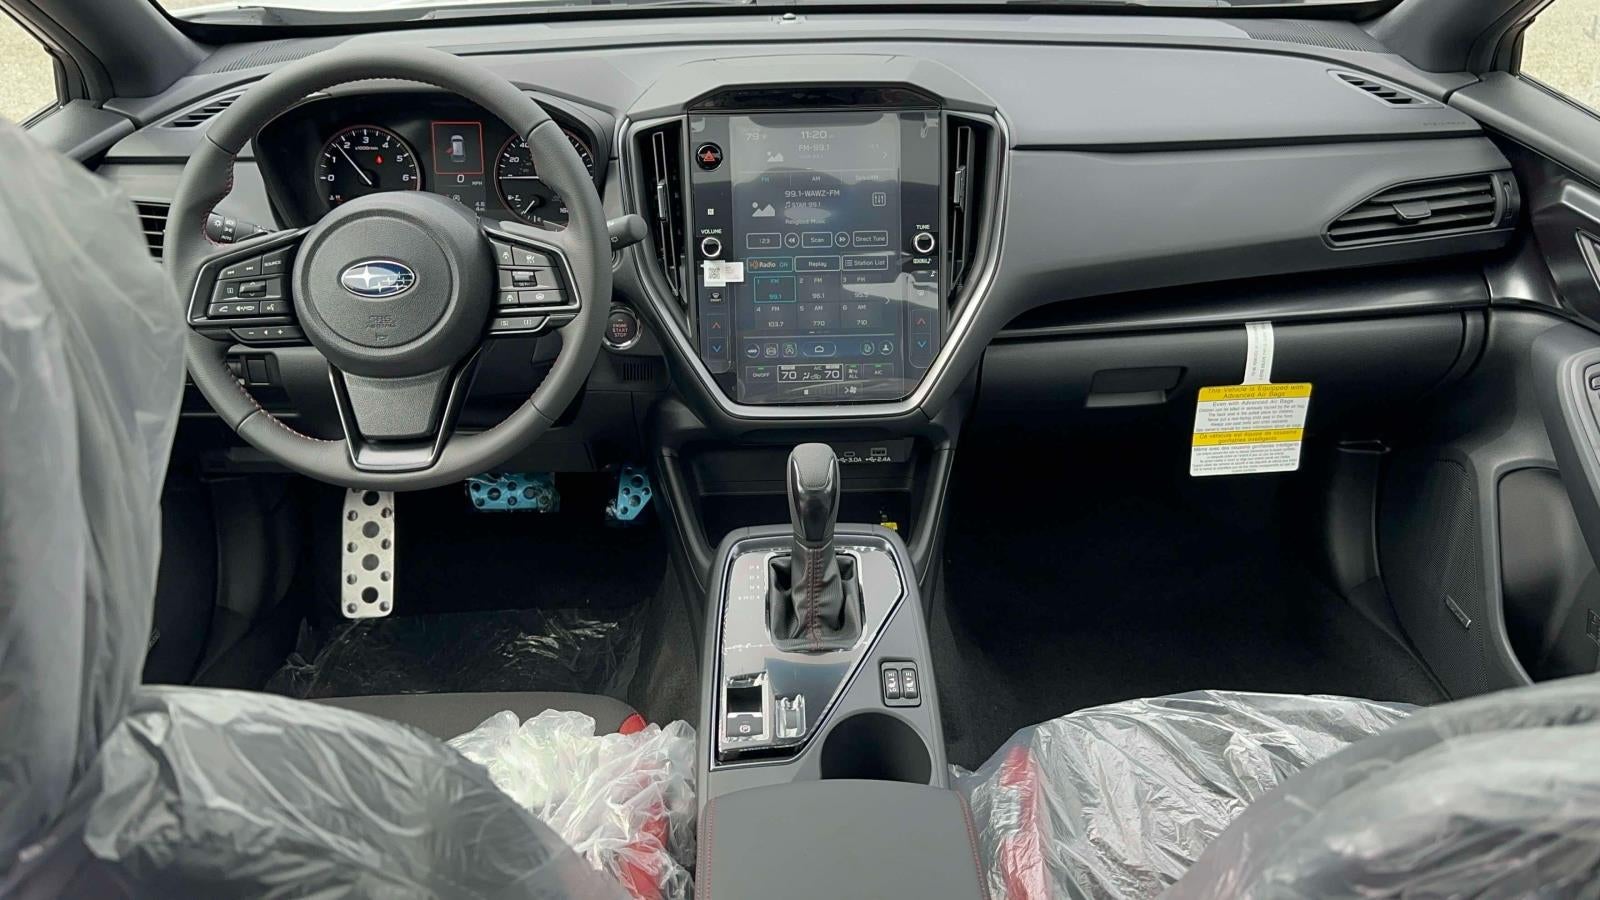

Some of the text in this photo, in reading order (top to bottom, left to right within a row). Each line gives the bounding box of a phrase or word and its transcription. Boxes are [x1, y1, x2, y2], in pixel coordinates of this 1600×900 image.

[800, 130, 828, 140] 11:20
[457, 175, 464, 183] 0
[781, 371, 797, 379] 70
[824, 370, 840, 378] 70
